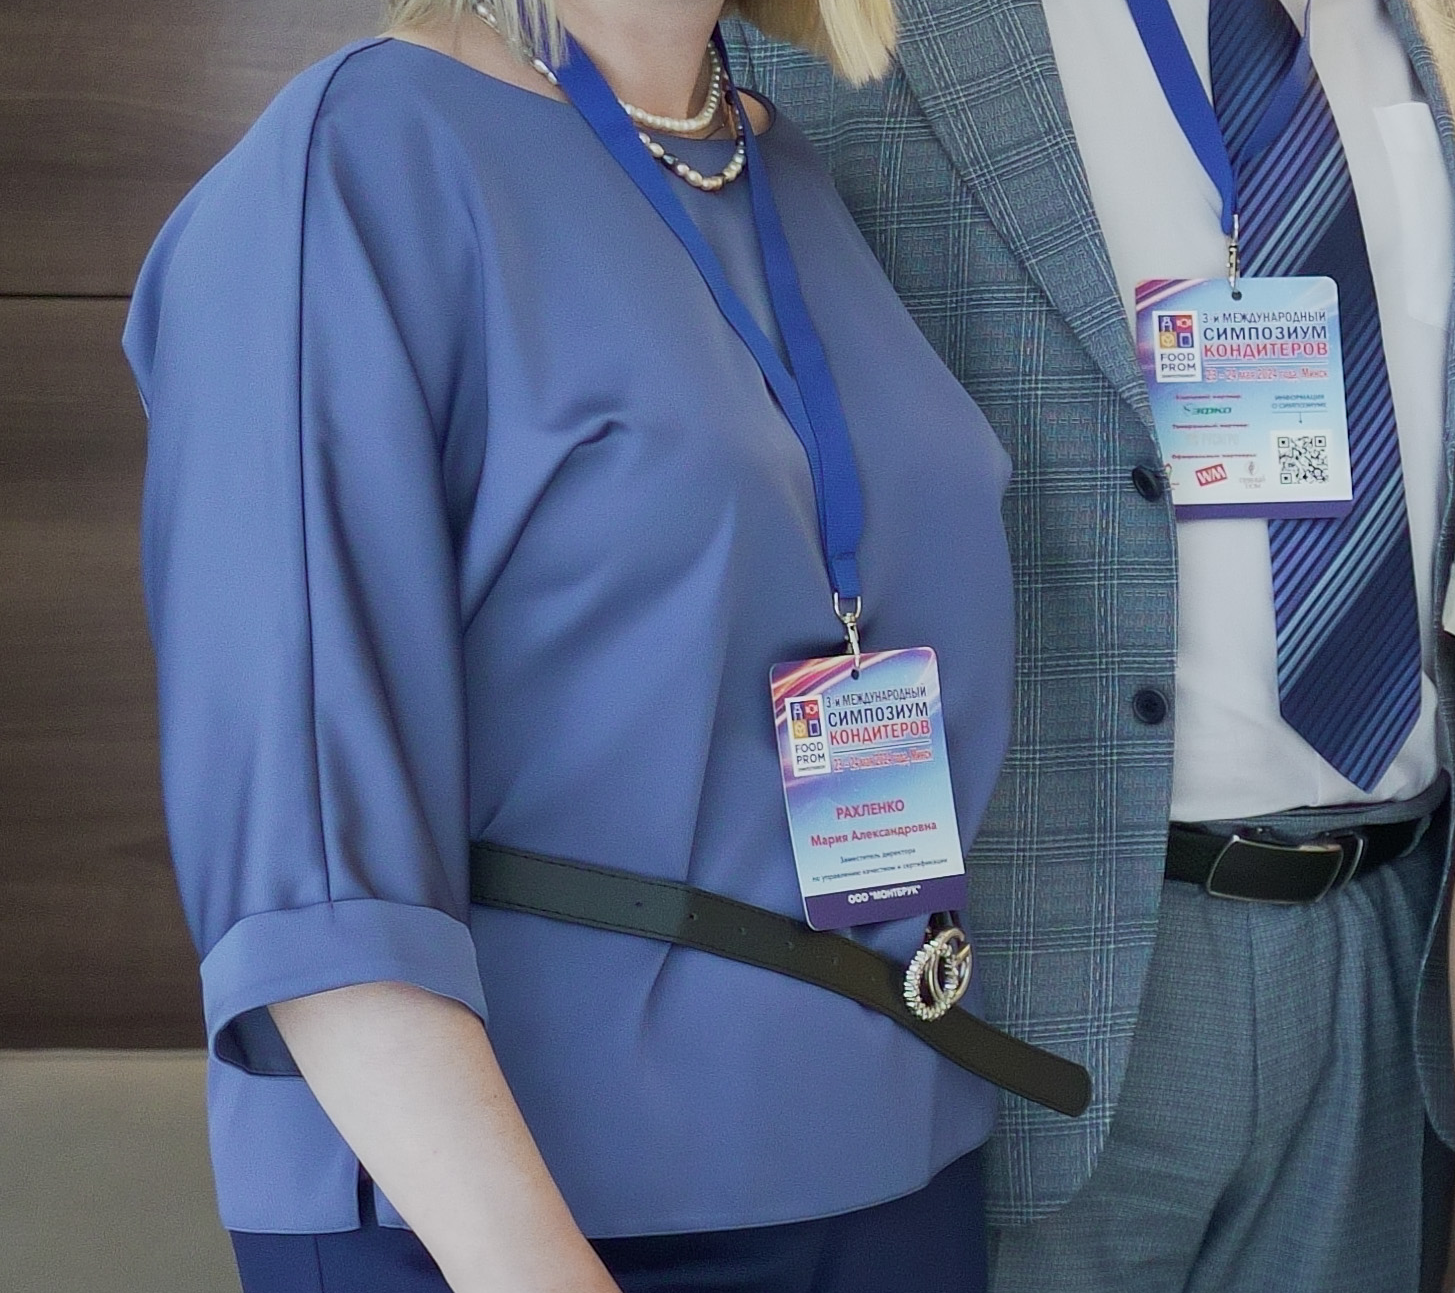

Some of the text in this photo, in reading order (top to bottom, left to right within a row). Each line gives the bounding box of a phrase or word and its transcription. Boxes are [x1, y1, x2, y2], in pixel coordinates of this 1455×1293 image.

[1223, 311, 1326, 323] МЕЖДУНАРОДНЫЙ
[1203, 325, 1327, 340] СИМПОЗИУМ
[1204, 342, 1328, 358] КОНДИТЕРОВ
[842, 685, 927, 706] МЕЖДУНАРОДНЫЙ
[828, 702, 929, 728] СИМПОЗИУМ
[831, 720, 930, 745] КОНДИТЕРОВ
[795, 742, 823, 753] FOOD
[797, 753, 826, 764] PROM
[836, 800, 905, 820] РАХЛЕНКО
[811, 821, 937, 848] Мария Александровна
[848, 891, 869, 904] ООО
